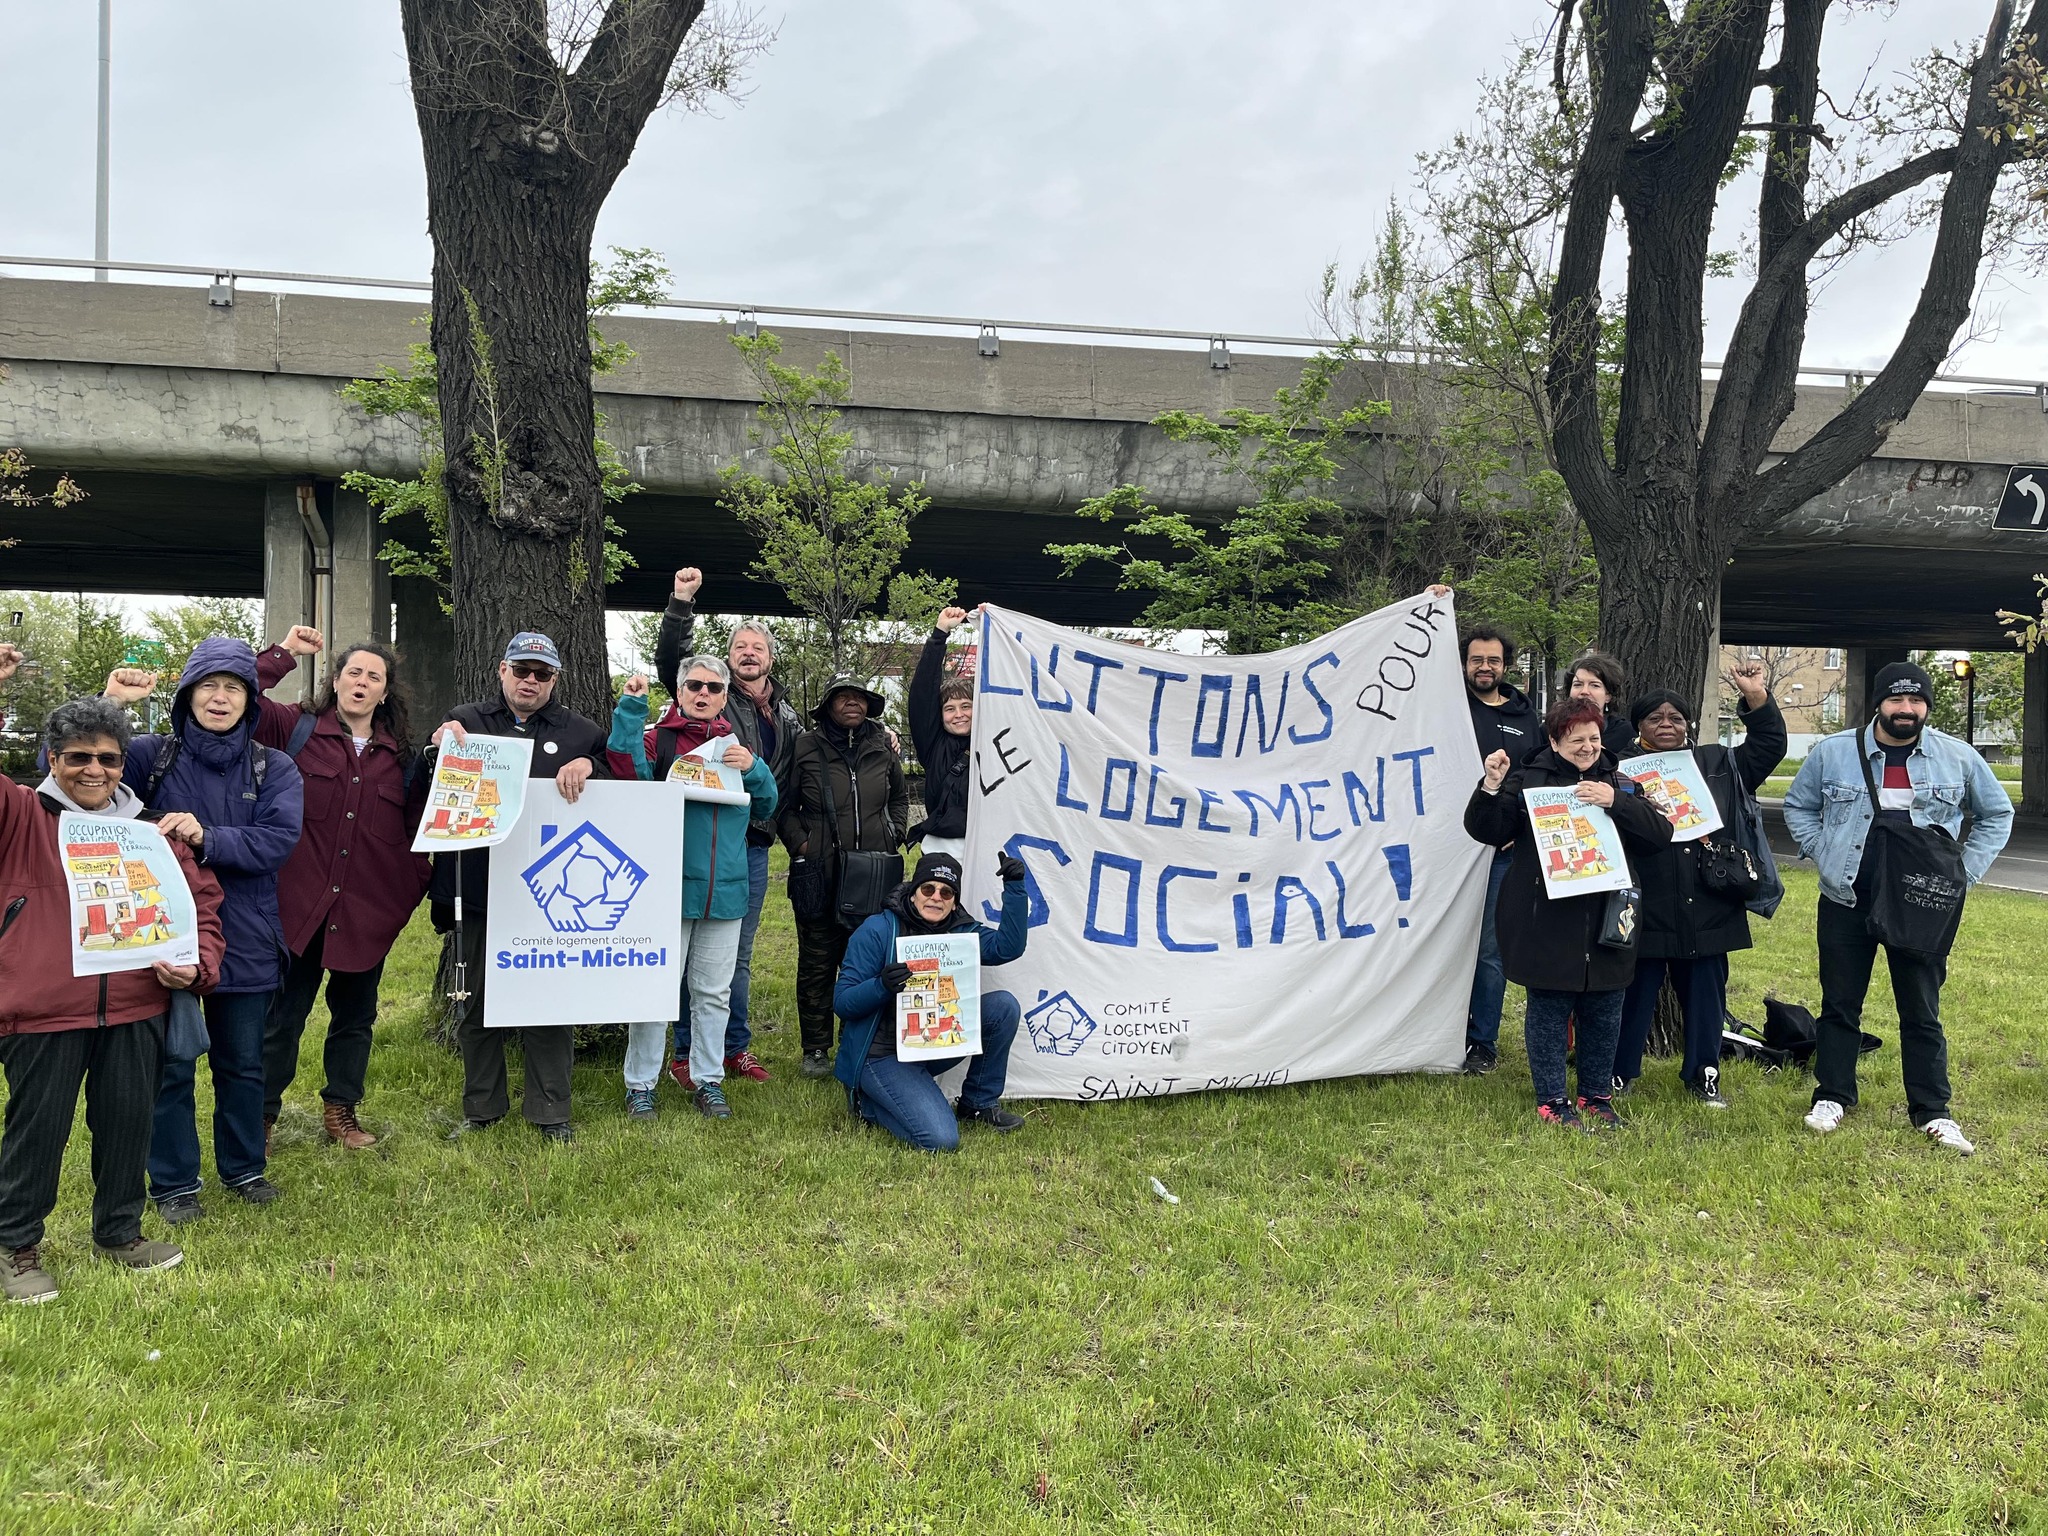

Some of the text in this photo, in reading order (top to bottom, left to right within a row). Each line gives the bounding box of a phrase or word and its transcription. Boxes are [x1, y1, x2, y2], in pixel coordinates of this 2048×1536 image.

[981, 602, 1446, 758] LUTTONS POUR
[975, 728, 1434, 841] LE LOGEMENT
[512, 935, 652, 948] Comité logement citoyen
[496, 946, 666, 969] Saint-Michel
[1104, 1019, 1190, 1037] LOGEMENT
